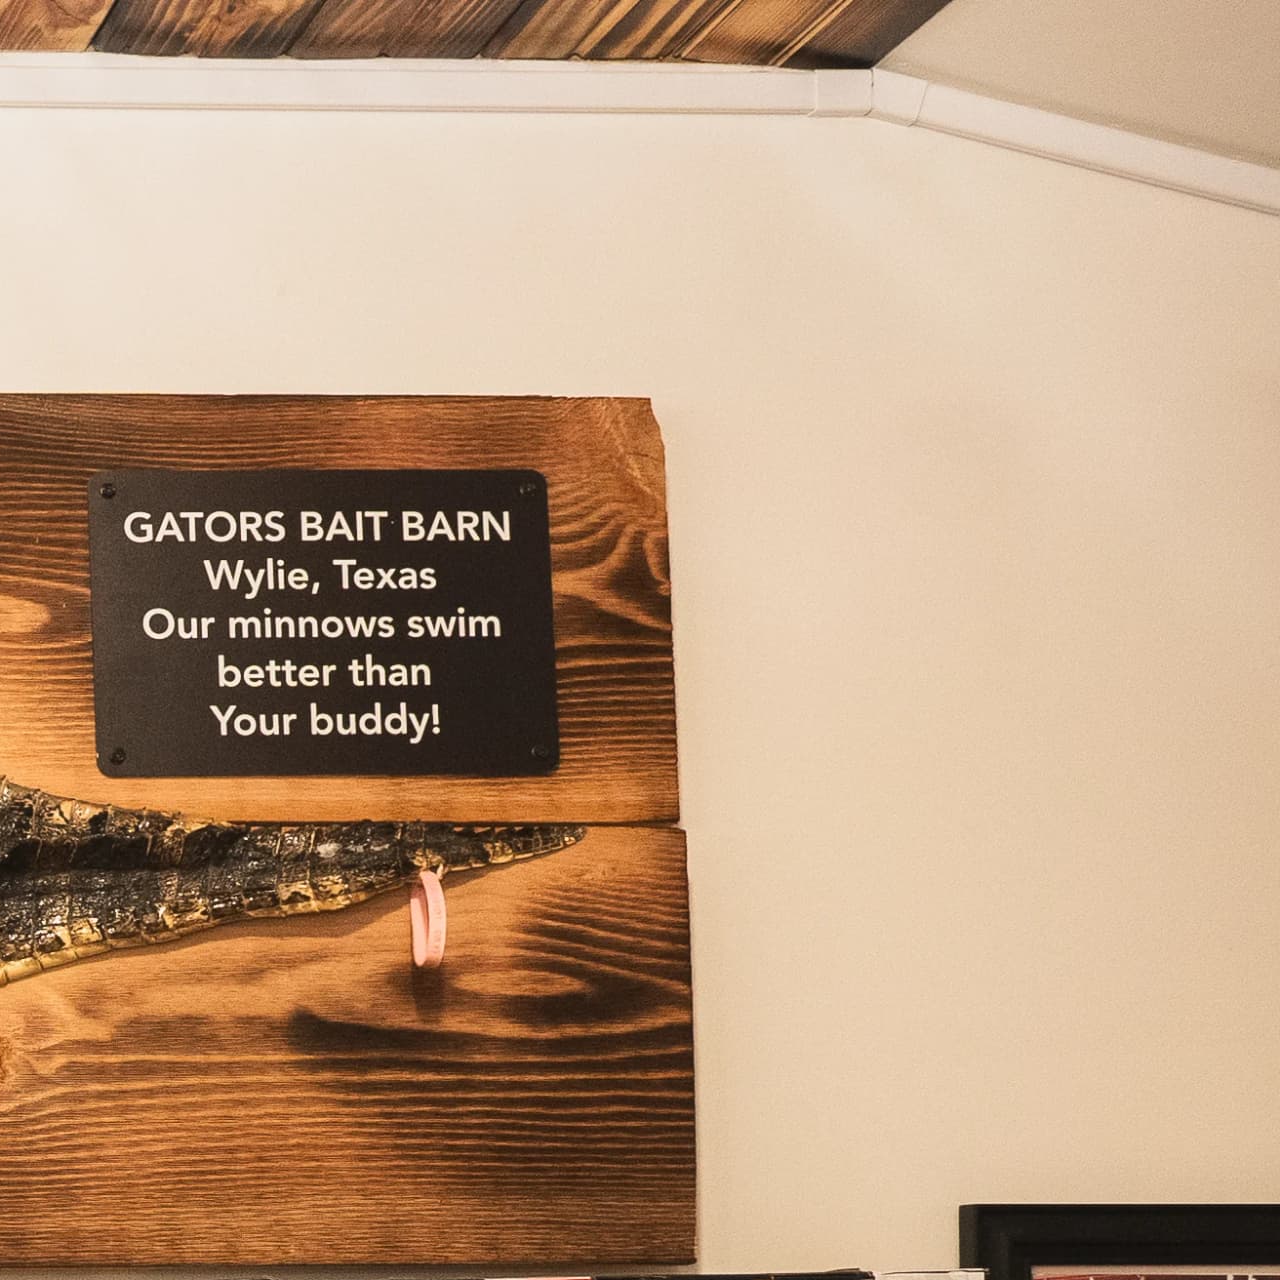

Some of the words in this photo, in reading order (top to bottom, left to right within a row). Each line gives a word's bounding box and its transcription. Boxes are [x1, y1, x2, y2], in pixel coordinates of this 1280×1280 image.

[123, 510, 286, 543] GATORS
[300, 510, 387, 542] BAIT
[402, 510, 510, 542] BARN
[204, 559, 320, 598] Wylie,
[333, 560, 437, 590] Texas
[142, 608, 214, 639] Our
[228, 608, 394, 638] minnows
[408, 608, 501, 638] swim
[218, 656, 336, 688] better
[348, 656, 431, 687] than
[210, 705, 296, 736] Your
[311, 703, 441, 744] buddy!
